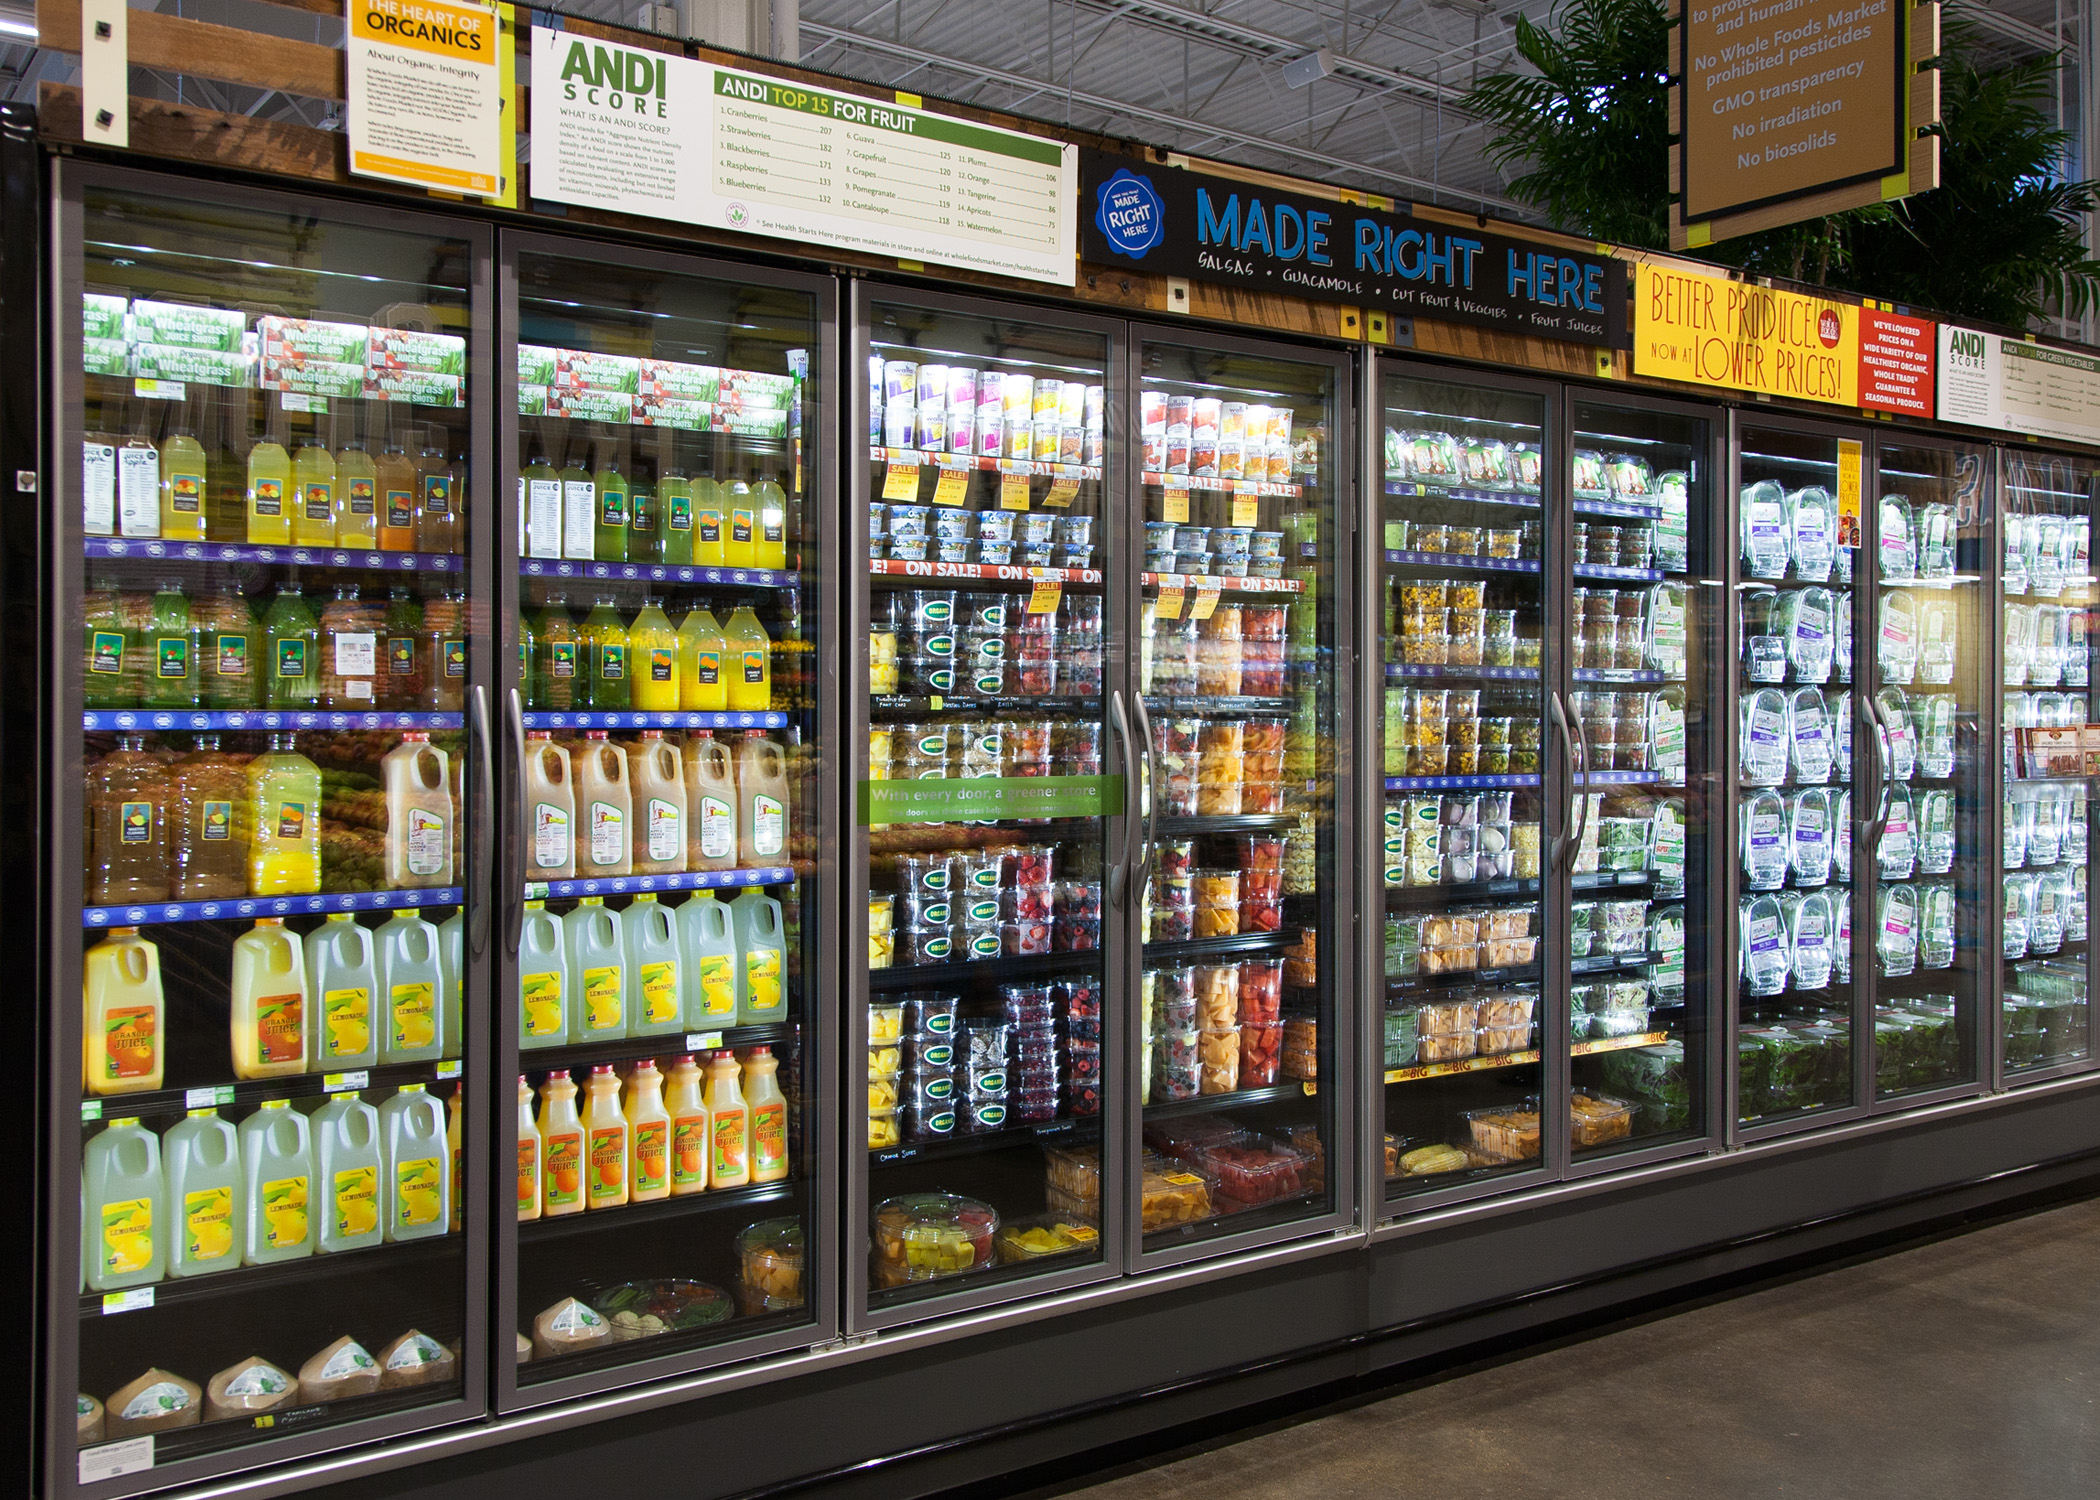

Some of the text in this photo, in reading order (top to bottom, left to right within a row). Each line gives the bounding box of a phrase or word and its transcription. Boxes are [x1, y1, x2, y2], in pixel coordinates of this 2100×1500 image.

[368, 0, 481, 32] THE HEART OF
[1693, 9, 1708, 24] to
[1716, 10, 1744, 35] and
[366, 12, 481, 51] ORGANICS
[1695, 0, 1887, 72] No Whole Foods Market
[367, 49, 480, 81] About Organic Integrity
[1706, 25, 1872, 91] prohibited pesticides
[560, 40, 666, 100] ANDI
[1712, 59, 1865, 115] GMO transparency
[564, 83, 667, 119] SCORE
[722, 76, 916, 133] ANDI TOP 15 FOR FRUIT
[560, 107, 671, 135] WHAT IS AN ANDI SCORE?
[727, 107, 768, 122] Cranberries
[1732, 99, 1842, 140] No irradiation
[727, 125, 771, 141] Strawberries
[853, 133, 875, 144] Guava
[727, 142, 770, 157] Blackberries
[853, 150, 887, 164] Grapefruit
[1737, 130, 1837, 170] No biosolids
[727, 160, 768, 175] Raspberries
[967, 157, 987, 167] Plums
[852, 167, 877, 179] Grapes
[967, 173, 990, 185] Orange
[726, 177, 766, 192] Blueberries
[852, 184, 896, 199] Pomegranate
[967, 189, 996, 202] Tangerine
[1114, 194, 1140, 208] MADE
[852, 201, 890, 215] Cantaloupe
[967, 205, 992, 217] Apricots
[1108, 203, 1151, 228] RIGHT
[967, 221, 1003, 235] Watermelon
[1122, 223, 1149, 238] HERE
[761, 220, 774, 229] See
[775, 221, 797, 232] Health
[798, 226, 817, 236] Starts
[818, 230, 834, 239] Here
[835, 233, 861, 244] program
[862, 237, 890, 248] materials
[898, 243, 913, 251] store
[913, 246, 925, 254] and
[926, 248, 943, 258] online
[1197, 187, 1604, 315] MADE RIGHT HERE
[1198, 251, 1254, 276] SALSAS
[1283, 268, 1363, 295] GUACAMOLE
[1392, 288, 1415, 302] CUT
[1420, 291, 1450, 308] FRUIT
[1531, 312, 1560, 328] FRUIT
[1566, 317, 1603, 335] JUICES
[1652, 272, 1816, 350] BETTER PRODUCE.
[154, 317, 229, 336] Wheatgrass
[1873, 320, 1920, 337] WE'VE LOWERED
[164, 331, 220, 345] JUICE SHOTS!
[1878, 333, 1899, 345] PRICES
[1900, 338, 1910, 347] ON
[1949, 330, 1985, 359] ANDI
[1863, 342, 1928, 362] WIDE VARIETY OF OUR
[2002, 343, 2018, 354] ANDI
[2036, 350, 2048, 360] FOR
[2047, 352, 2065, 364] GREEN
[2065, 355, 2095, 370] VEGETABLES
[1651, 334, 1842, 400] NOW AT LOWER PRICES!
[1863, 355, 1929, 375] HEALTHIEST ORGANIC,
[1950, 354, 1985, 370] SCORE
[1873, 369, 1896, 381] WHOLE
[1875, 382, 1910, 396] GUARANTEE
[1865, 392, 1926, 410] SEASONAL PRODUCE.
[891, 464, 916, 475] SALE!
[942, 470, 966, 480] SALE!
[1260, 482, 1296, 497] SALE!
[905, 561, 982, 578] ON SALE!
[1240, 577, 1300, 592] ON SALE!
[872, 786, 1096, 803] With every door, a greener store
[528, 994, 557, 1003] LEMONADE
[332, 1011, 365, 1022] LEMONADE
[398, 1006, 430, 1016] LEMONADE
[114, 1030, 148, 1039] ORANGE
[114, 1037, 147, 1050] JUICE
[1452, 1060, 1471, 1072] BIG
[595, 1155, 620, 1166] JUICE
[639, 1148, 664, 1159] JUICE
[192, 1212, 228, 1224] LEMONADE
[110, 1224, 147, 1237] LEMONADE
